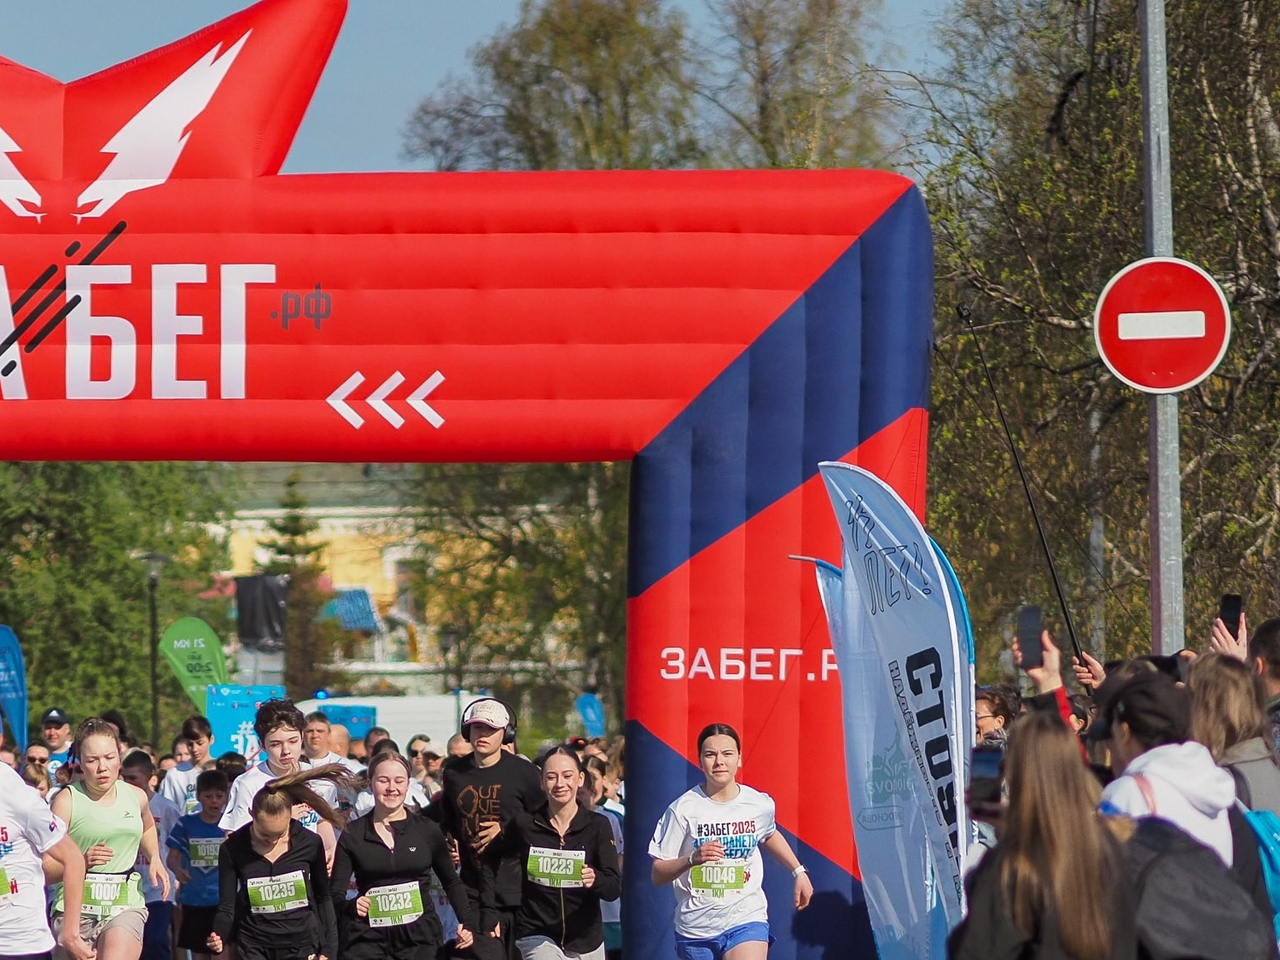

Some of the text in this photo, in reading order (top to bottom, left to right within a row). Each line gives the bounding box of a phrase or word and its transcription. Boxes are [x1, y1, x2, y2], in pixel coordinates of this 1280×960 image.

[660, 646, 842, 681] ЗАБЕГ.Р
[697, 820, 756, 837] #ЗАБЕГ2025
[538, 857, 574, 875] 10223
[701, 866, 736, 884] 10046
[258, 882, 296, 901] 10235
[376, 891, 413, 912] 10232
